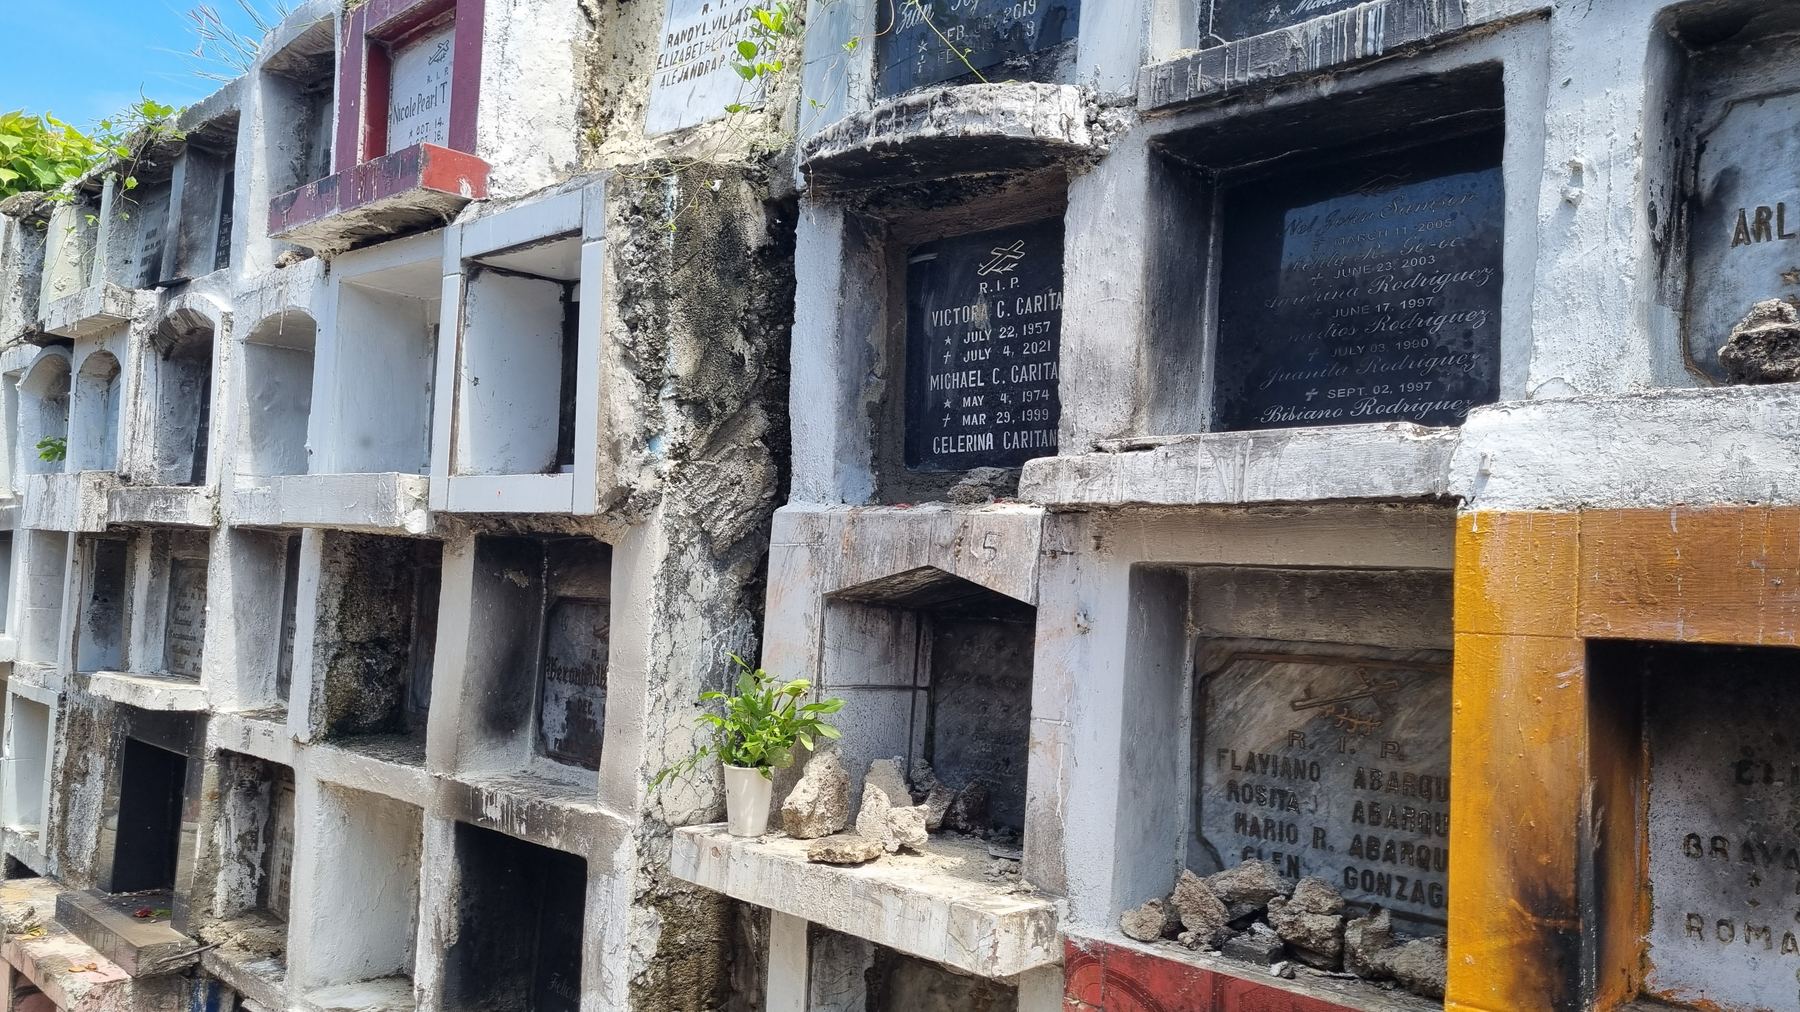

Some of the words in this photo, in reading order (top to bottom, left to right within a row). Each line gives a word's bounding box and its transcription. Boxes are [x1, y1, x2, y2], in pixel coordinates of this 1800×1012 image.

[1003, 0, 1036, 23] 2019
[667, 22, 702, 48] RANDY
[660, 58, 717, 88] ALEJANDRA
[416, 85, 438, 115] Pearl
[440, 81, 448, 104] T
[1731, 202, 1796, 247] ARL
[1334, 265, 1373, 279] JUNE
[1401, 255, 1436, 269] 2003
[1366, 266, 1494, 294] Rodriguez
[996, 301, 1012, 318] C.
[1331, 305, 1371, 319] JUNE
[1400, 297, 1435, 310] 1997
[963, 329, 992, 344] JULY
[1023, 320, 1051, 335] 1957
[1364, 309, 1490, 335] Rodriguez
[963, 348, 992, 363] JULY
[1023, 339, 1051, 354] 2021
[1356, 352, 1480, 377] Rodriguez
[930, 370, 985, 391] MICHAEL
[992, 367, 1006, 384] C.
[1400, 381, 1432, 393] 1997
[962, 395, 984, 408] MAY
[1022, 389, 1049, 402] 1974
[962, 413, 987, 426] MAR
[1021, 408, 1049, 422] 1999
[933, 433, 993, 454] CELERINA
[1217, 747, 1321, 783] FLAVIANO
[1226, 779, 1301, 815] ROSITA
[1312, 826, 1335, 852] R.
[1343, 866, 1445, 909] GONZAG
[1685, 913, 1800, 955] ROMA
